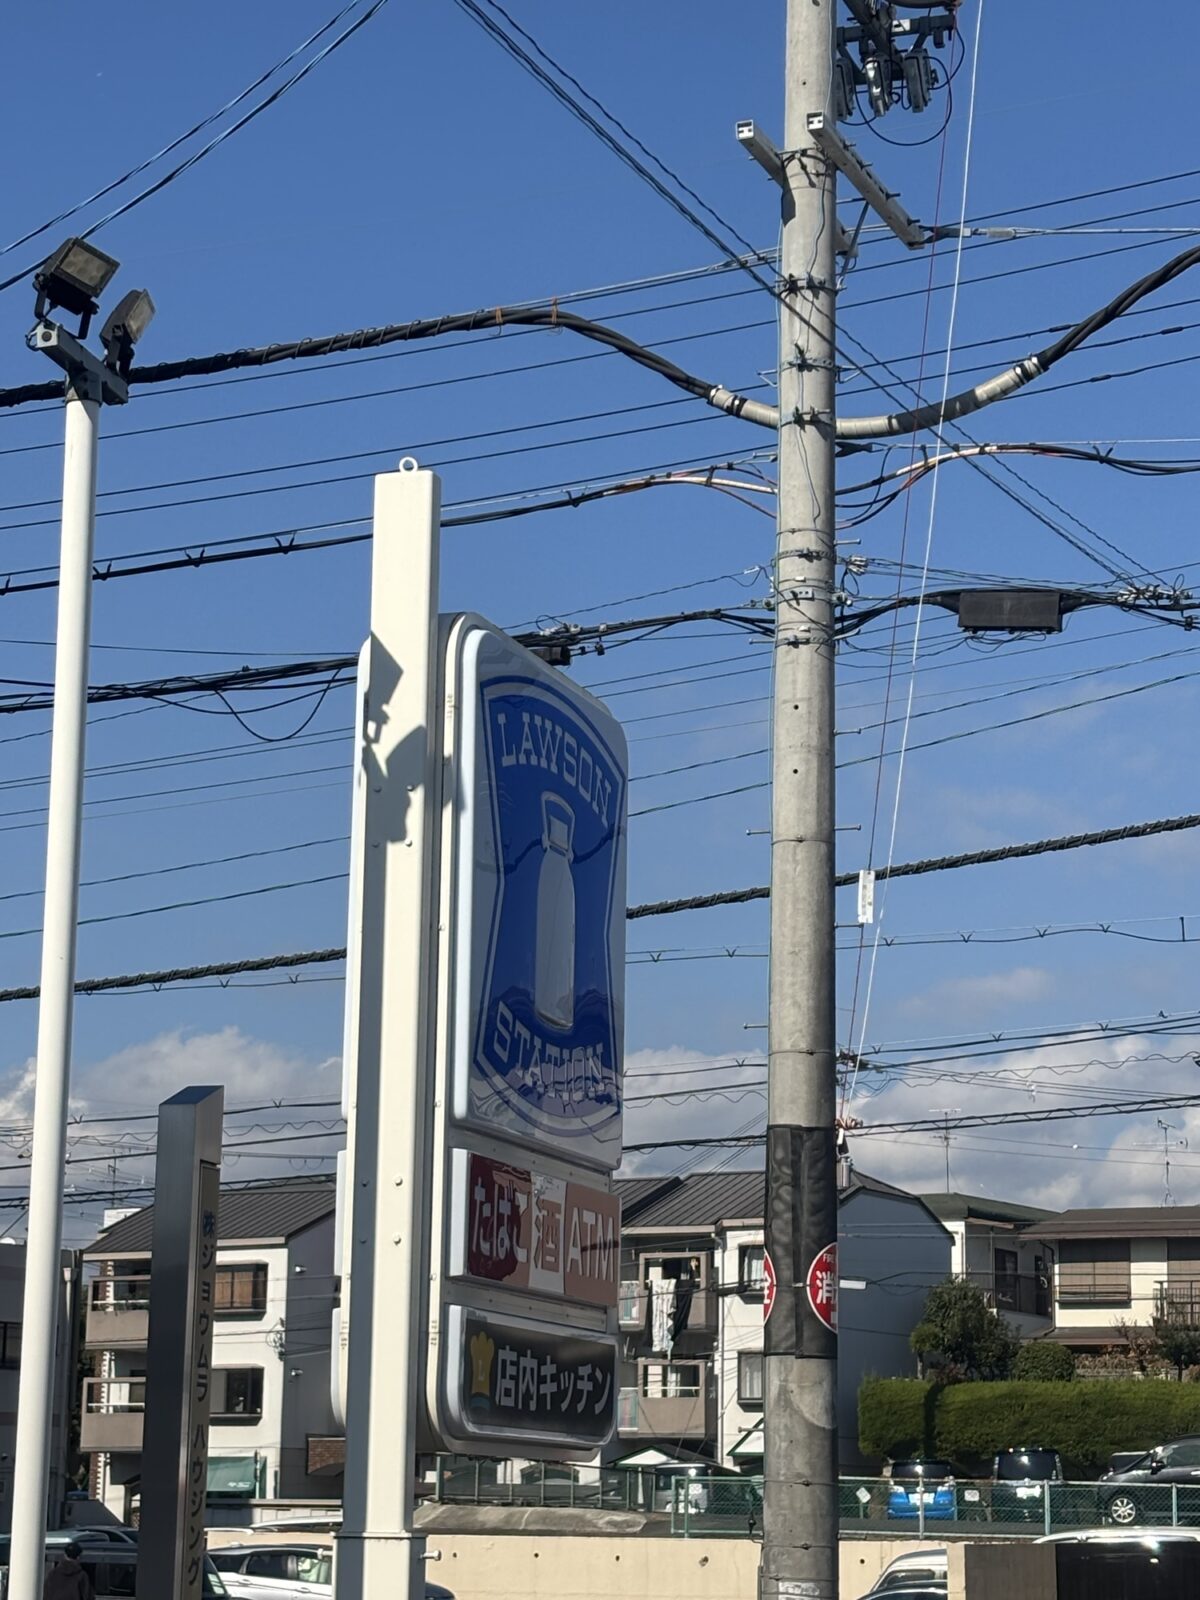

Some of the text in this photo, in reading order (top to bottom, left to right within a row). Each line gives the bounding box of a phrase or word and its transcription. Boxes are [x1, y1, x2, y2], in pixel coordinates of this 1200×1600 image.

[497, 710, 612, 829] LAWSON
[493, 1000, 604, 1104] STATION
[567, 1207, 615, 1283] ATM
[495, 1345, 611, 1415] 店内キッチン
[188, 1423, 206, 1586] ハウジング
